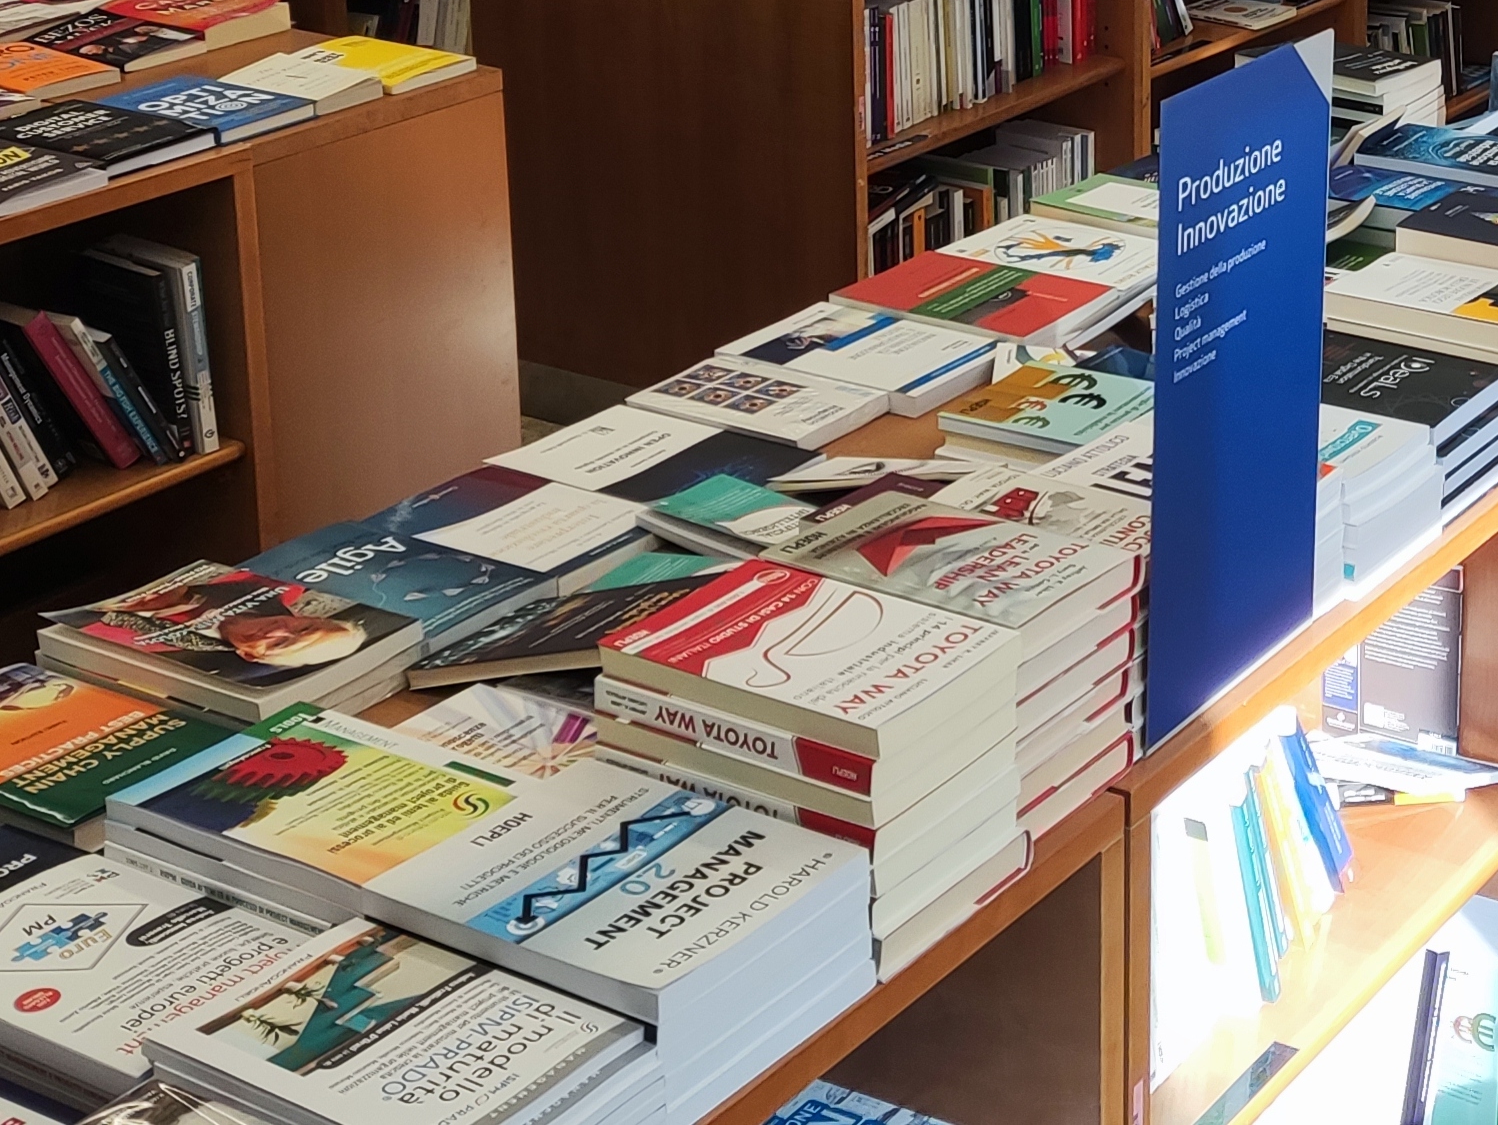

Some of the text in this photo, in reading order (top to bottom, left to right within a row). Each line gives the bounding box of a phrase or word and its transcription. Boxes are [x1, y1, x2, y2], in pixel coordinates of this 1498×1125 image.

[34, 13, 108, 42] BEZOS
[136, 83, 225, 113] OPTI
[158, 88, 255, 118] MIZA
[34, 107, 104, 133] DIGITAL
[36, 108, 131, 140] CUSTOMER
[61, 115, 133, 139] SERVICE
[1177, 137, 1283, 212] Produzione
[1176, 177, 1286, 256] Innovazione
[1175, 238, 1267, 299] Gestione della produzione
[1174, 291, 1209, 320] Logistica
[1173, 309, 1247, 363] Project management
[1174, 315, 1202, 341] Qualità
[164, 328, 181, 370] BLIND
[1173, 349, 1217, 384] Innovazione
[643, 431, 672, 450] OPEN
[781, 530, 828, 554] HOEPLI
[296, 535, 407, 585] Agile
[933, 533, 1038, 591] LEADERSHIP
[971, 542, 1089, 608] TOYOTA WAY
[974, 554, 1029, 583] LEAN
[221, 586, 290, 616] UNA VITA
[792, 576, 819, 599] CON
[745, 614, 760, 626] DI
[758, 598, 785, 620] CASI
[613, 628, 652, 648] HOEPLI
[708, 620, 749, 646] STUDIO
[886, 630, 924, 655] principi
[668, 638, 712, 665] ITALIANI
[838, 635, 899, 678] industriale
[873, 649, 888, 664] per
[833, 621, 984, 716] TOYOTA WAY
[267, 711, 317, 734] TOOLS
[654, 707, 779, 761] TOYOTA WAY
[0, 710, 145, 778] BEST PRACTICES
[14, 713, 170, 789] MANAGEMENT
[22, 718, 187, 795] SUPPLY CHAIN
[436, 781, 470, 798] Guida
[597, 794, 618, 810] PER
[337, 803, 408, 839] management
[400, 803, 428, 818] temi
[326, 828, 375, 854] processi
[468, 812, 532, 848] HOEPLI
[531, 814, 587, 849] SUCCESSO
[513, 847, 532, 858] DEI
[518, 826, 591, 870] METODOLOGIE
[451, 873, 511, 908] METRICHE
[459, 858, 514, 891] PROGETTI
[582, 829, 768, 951] MANAGEMENT
[618, 862, 677, 896] 2.0
[645, 860, 764, 940] PROJECT
[662, 857, 827, 970] HAROLD KERZNER
[21, 912, 58, 937] PM
[58, 928, 114, 961] Euro
[119, 935, 289, 1035] e progetti europei
[525, 1003, 556, 1021] di
[554, 1010, 582, 1026] Il
[396, 1021, 524, 1107] maturità
[438, 1024, 555, 1103] modello
